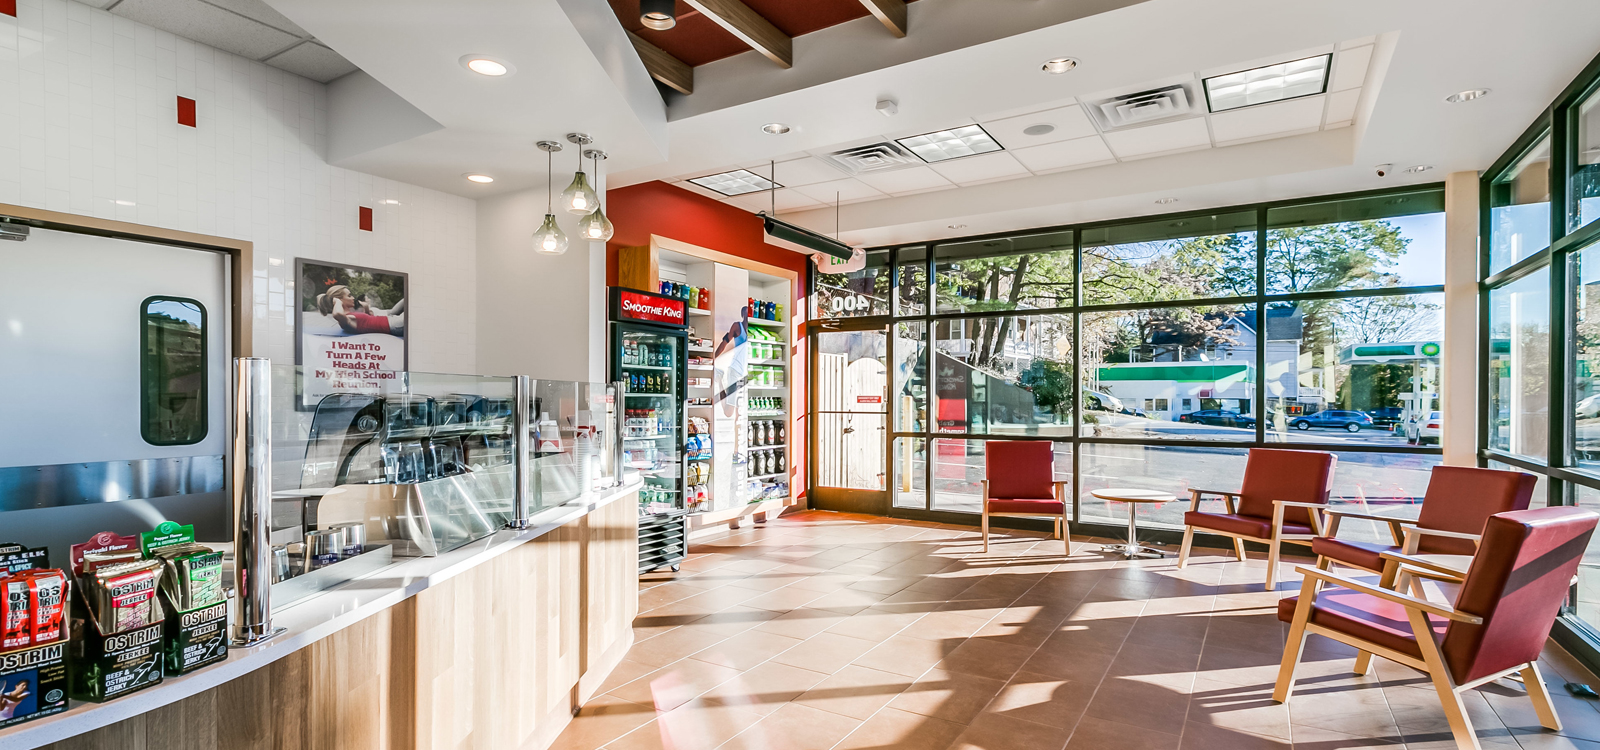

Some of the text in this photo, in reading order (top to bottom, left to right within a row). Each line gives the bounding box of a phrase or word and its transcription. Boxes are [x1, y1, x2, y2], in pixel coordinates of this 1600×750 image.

[622, 300, 662, 316] SMOOTHIE
[332, 341, 336, 349] I
[338, 342, 366, 350] Want
[326, 351, 352, 360] Turn
[333, 361, 366, 370] Heads
[315, 370, 396, 380] My High School
[332, 380, 381, 388] Reunion.
[22, 550, 45, 558] ELK
[112, 579, 154, 597] OSTRIM
[182, 603, 226, 628] OSTRIM
[104, 624, 160, 652] OSTRIM
[117, 646, 149, 662] JERKEE
[184, 644, 197, 654] BEEF
[184, 648, 206, 659] OSTRICH
[184, 655, 201, 665] JERKY
[106, 670, 123, 680] BEEF
[105, 674, 134, 687] OSTRICH
[105, 682, 127, 693] JERKY
